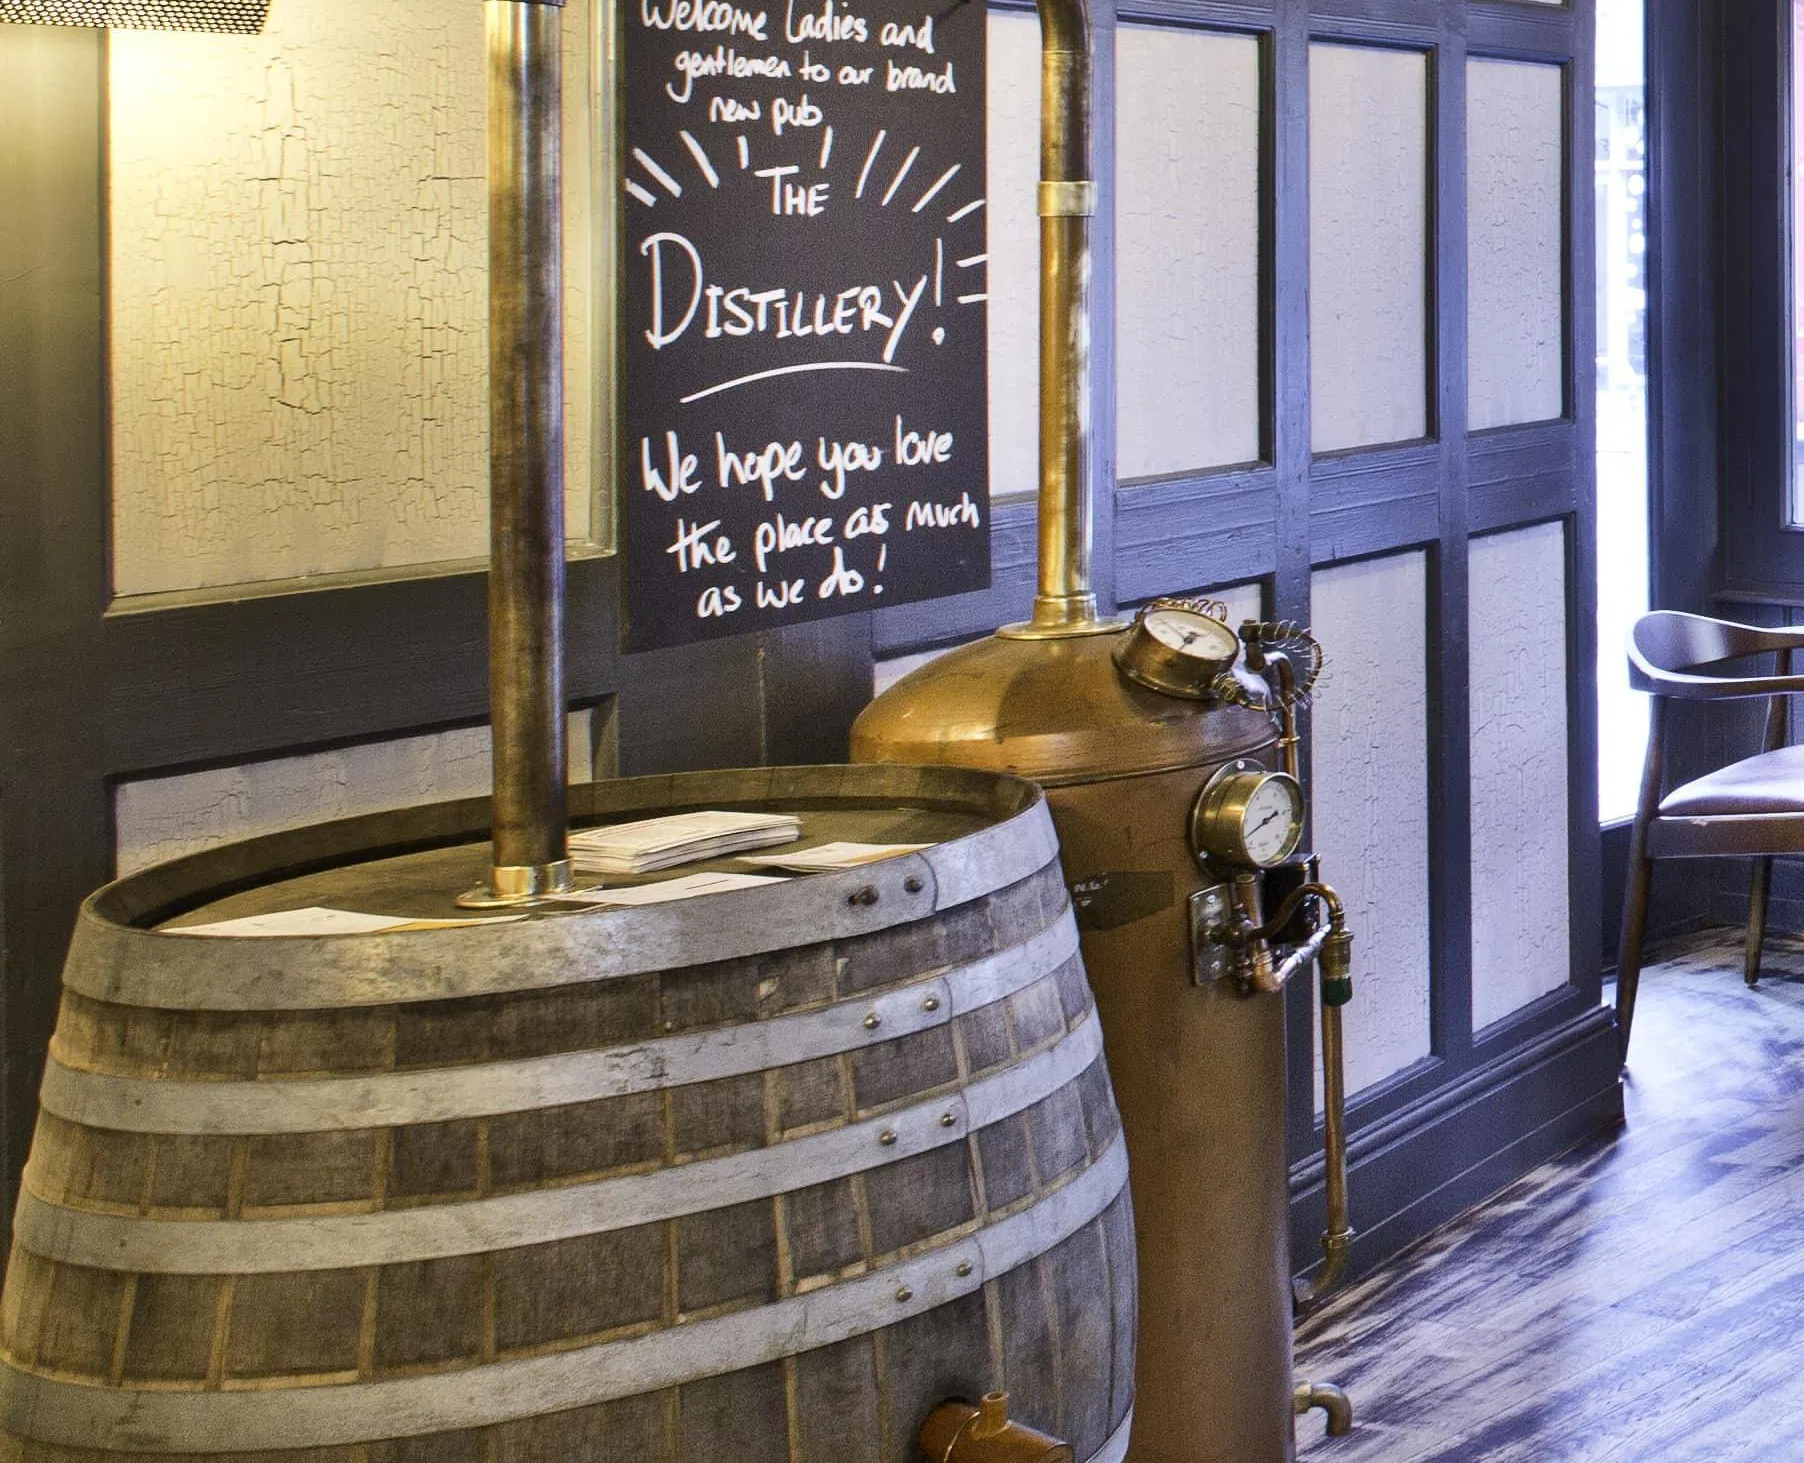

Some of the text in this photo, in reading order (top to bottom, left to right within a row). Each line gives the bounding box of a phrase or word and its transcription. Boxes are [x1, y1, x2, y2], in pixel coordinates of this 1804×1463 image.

[880, 16, 934, 54] and
[667, 46, 956, 103] gentlemen to our brand
[710, 94, 823, 135] new pub
[754, 165, 830, 217] THE
[641, 233, 945, 364] DISTILLERY!
[643, 415, 953, 502] We hope you love
[667, 519, 736, 572] the
[756, 508, 832, 556] place
[845, 503, 890, 538] as
[698, 543, 886, 617] as we do!
